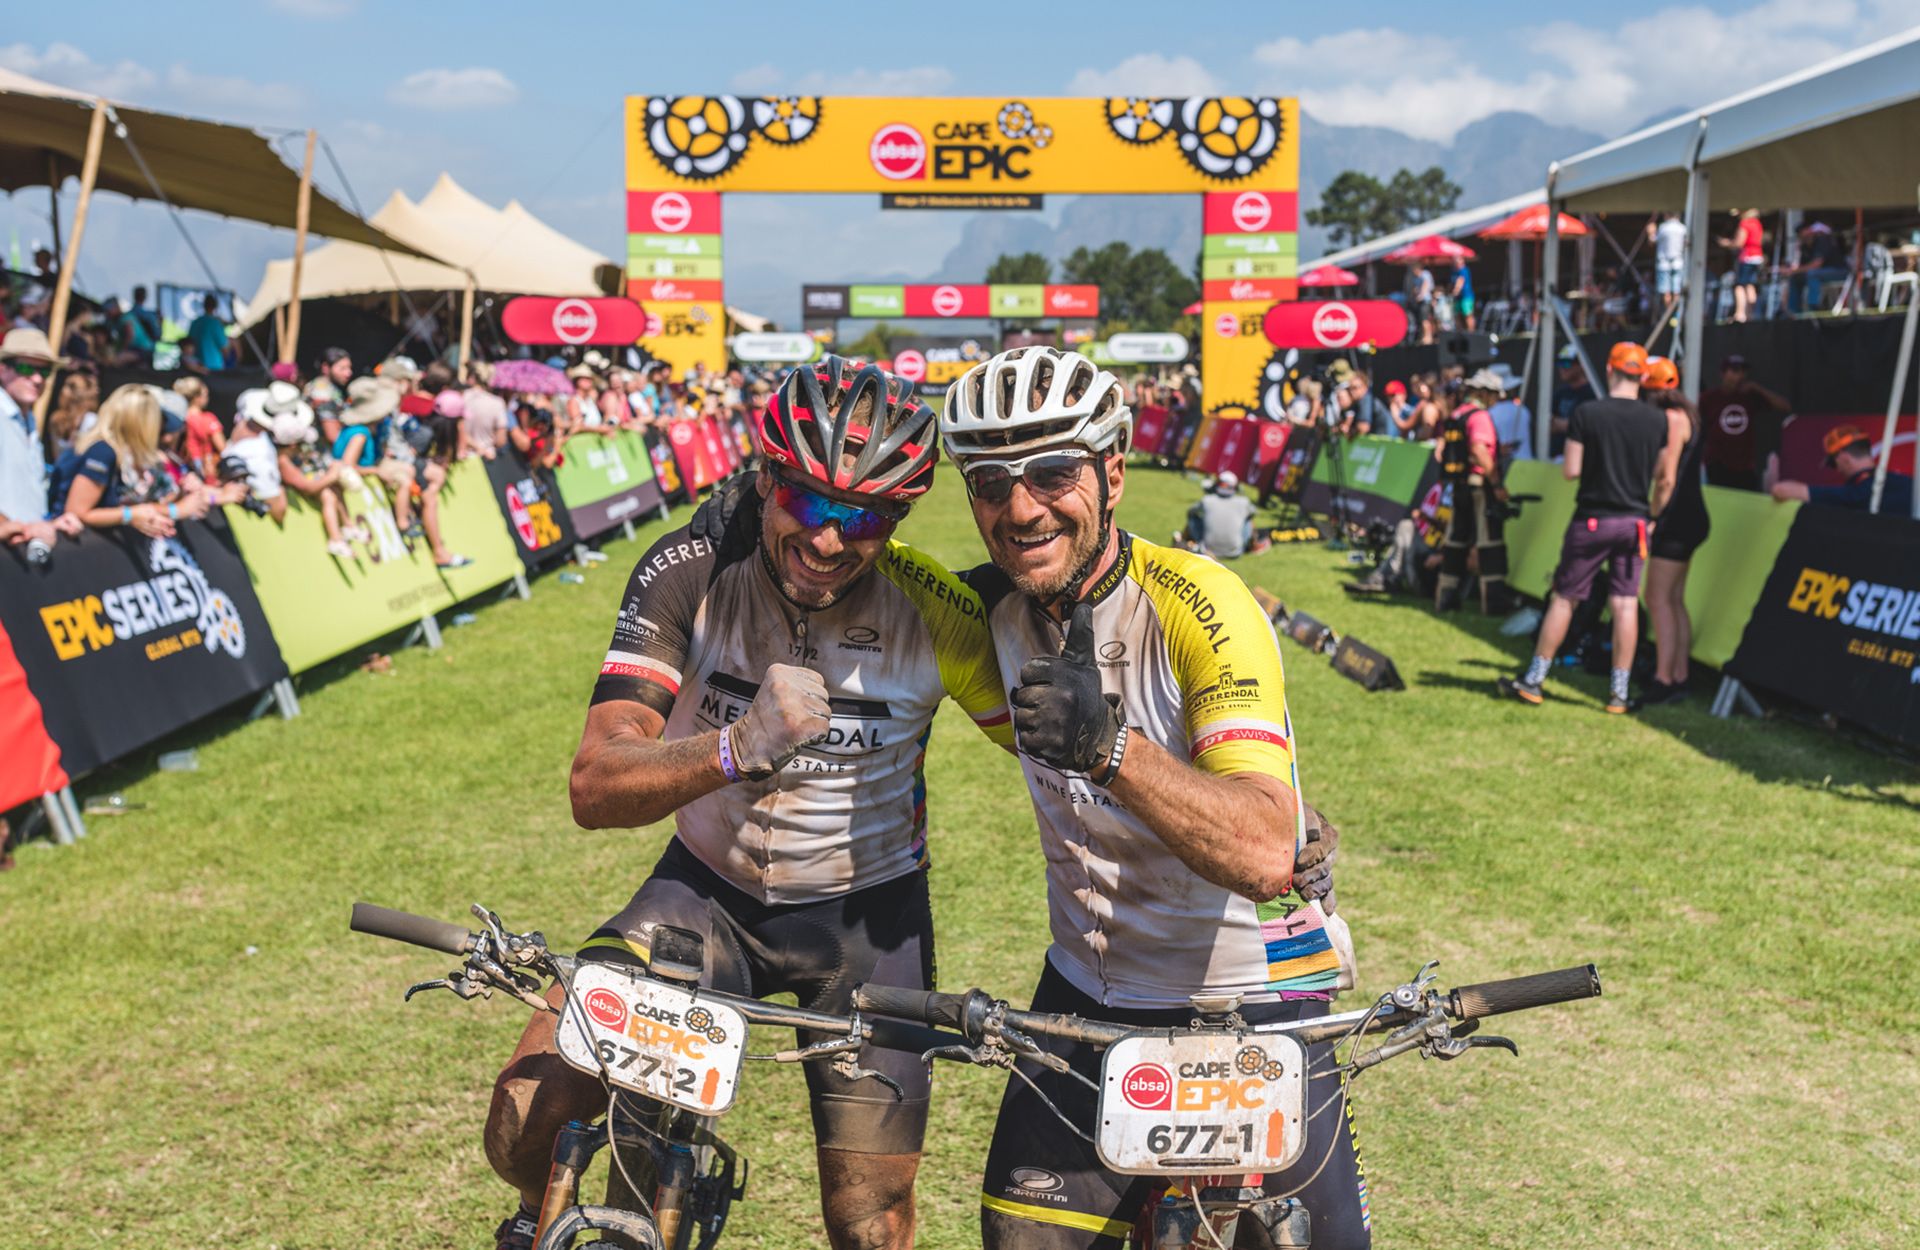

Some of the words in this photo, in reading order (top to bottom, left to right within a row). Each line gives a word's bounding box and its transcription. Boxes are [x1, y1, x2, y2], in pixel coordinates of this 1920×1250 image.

[933, 122, 991, 140] CAPE
[934, 145, 1032, 180] EPIC
[1145, 559, 1231, 655] MEERENDAL
[613, 663, 650, 677] SWISS
[1204, 731, 1228, 747] DT
[1231, 730, 1271, 742] SWISS
[1034, 774, 1067, 799] WINE
[591, 997, 621, 1018] absa
[633, 1002, 682, 1027] CAPE
[627, 1015, 708, 1060] EPIC
[596, 1038, 697, 1095] 677-2
[1178, 1062, 1231, 1079] CAPE
[1129, 1079, 1165, 1092] absa
[1175, 1078, 1266, 1111] EPIC
[1146, 1123, 1254, 1155] 677-1
